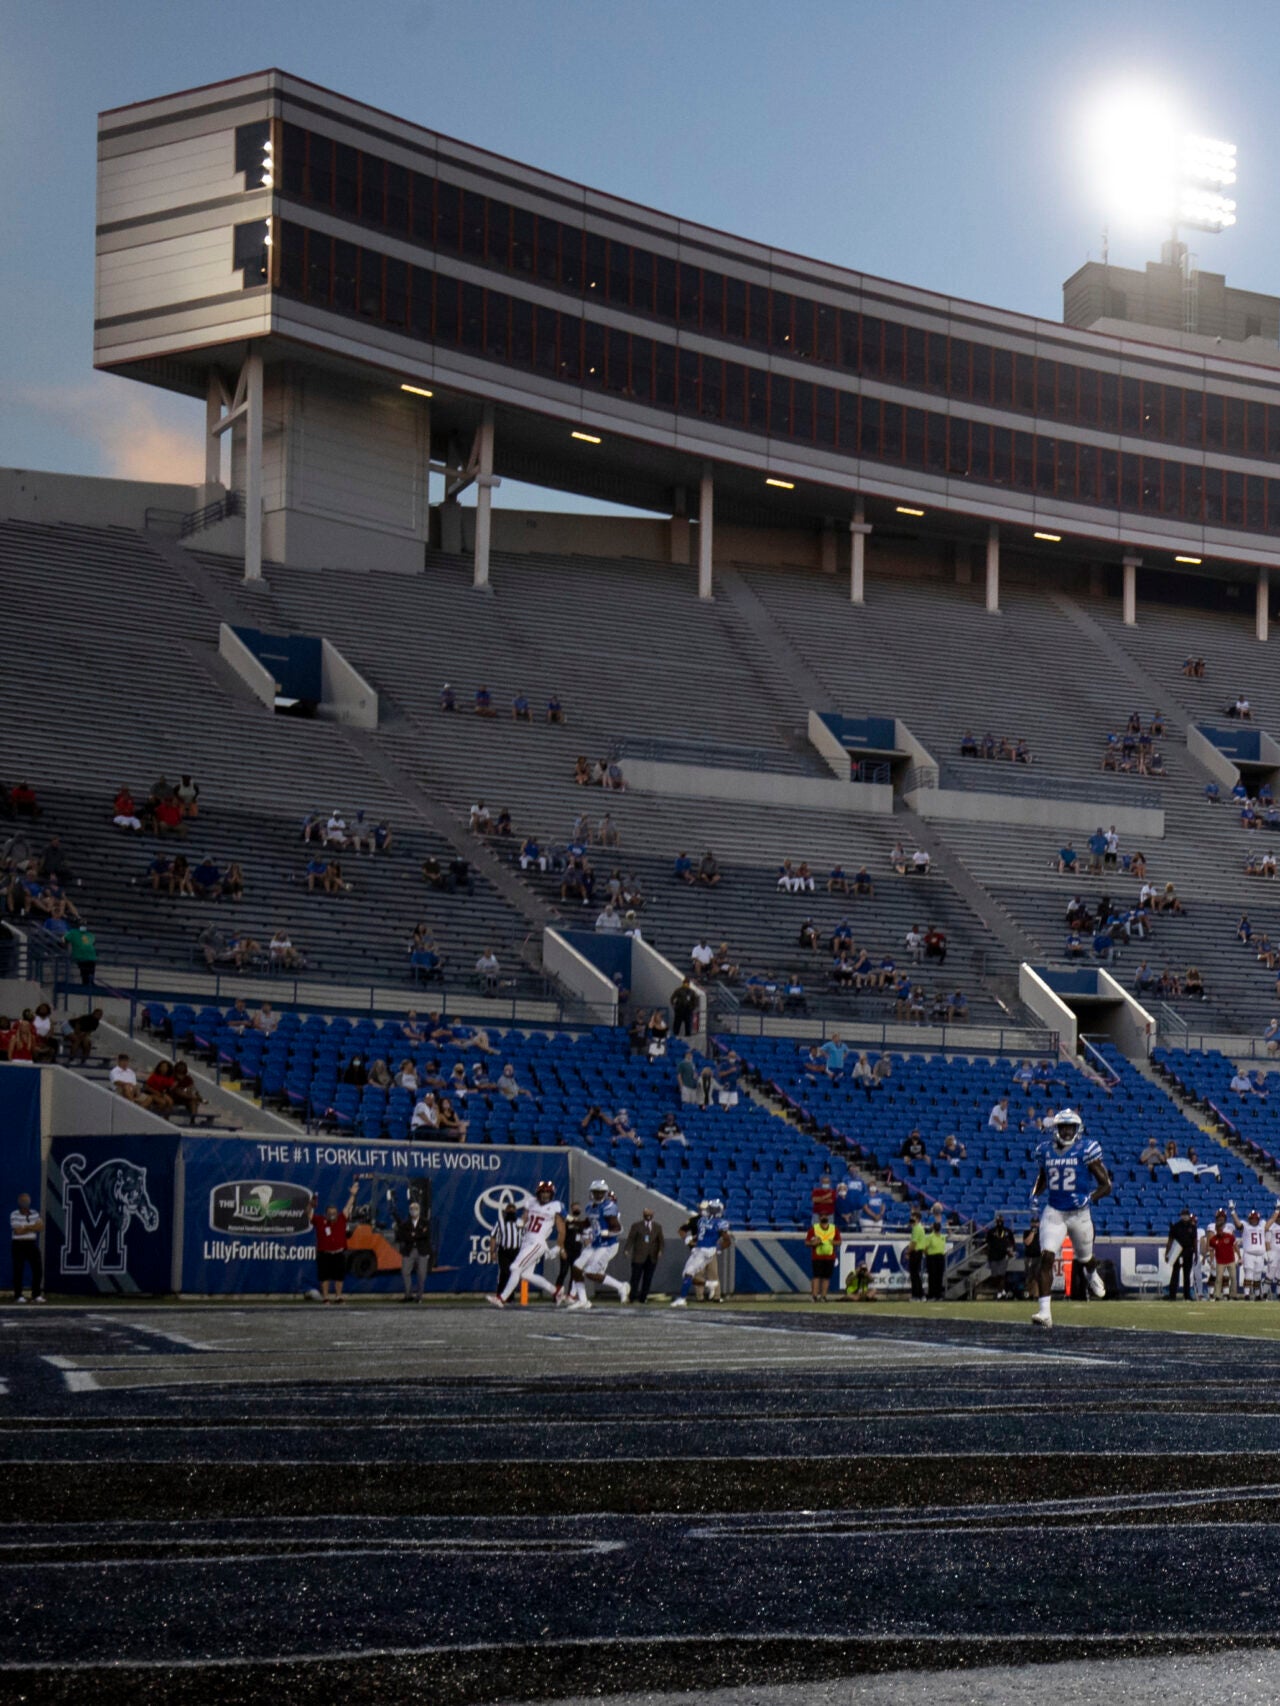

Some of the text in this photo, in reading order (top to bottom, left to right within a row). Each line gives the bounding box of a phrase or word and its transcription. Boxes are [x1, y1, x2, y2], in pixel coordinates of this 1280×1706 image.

[257, 1144, 501, 1171] THE #1 FORKLIFT IN THE WORLD
[1045, 1157, 1078, 1166] MEMPHIS
[1048, 1166, 1077, 1191] 22
[219, 1199, 235, 1209] THE
[528, 1213, 545, 1233] 16
[1251, 1232, 1262, 1246] 61
[204, 1240, 316, 1263] LillyForklifts.com
